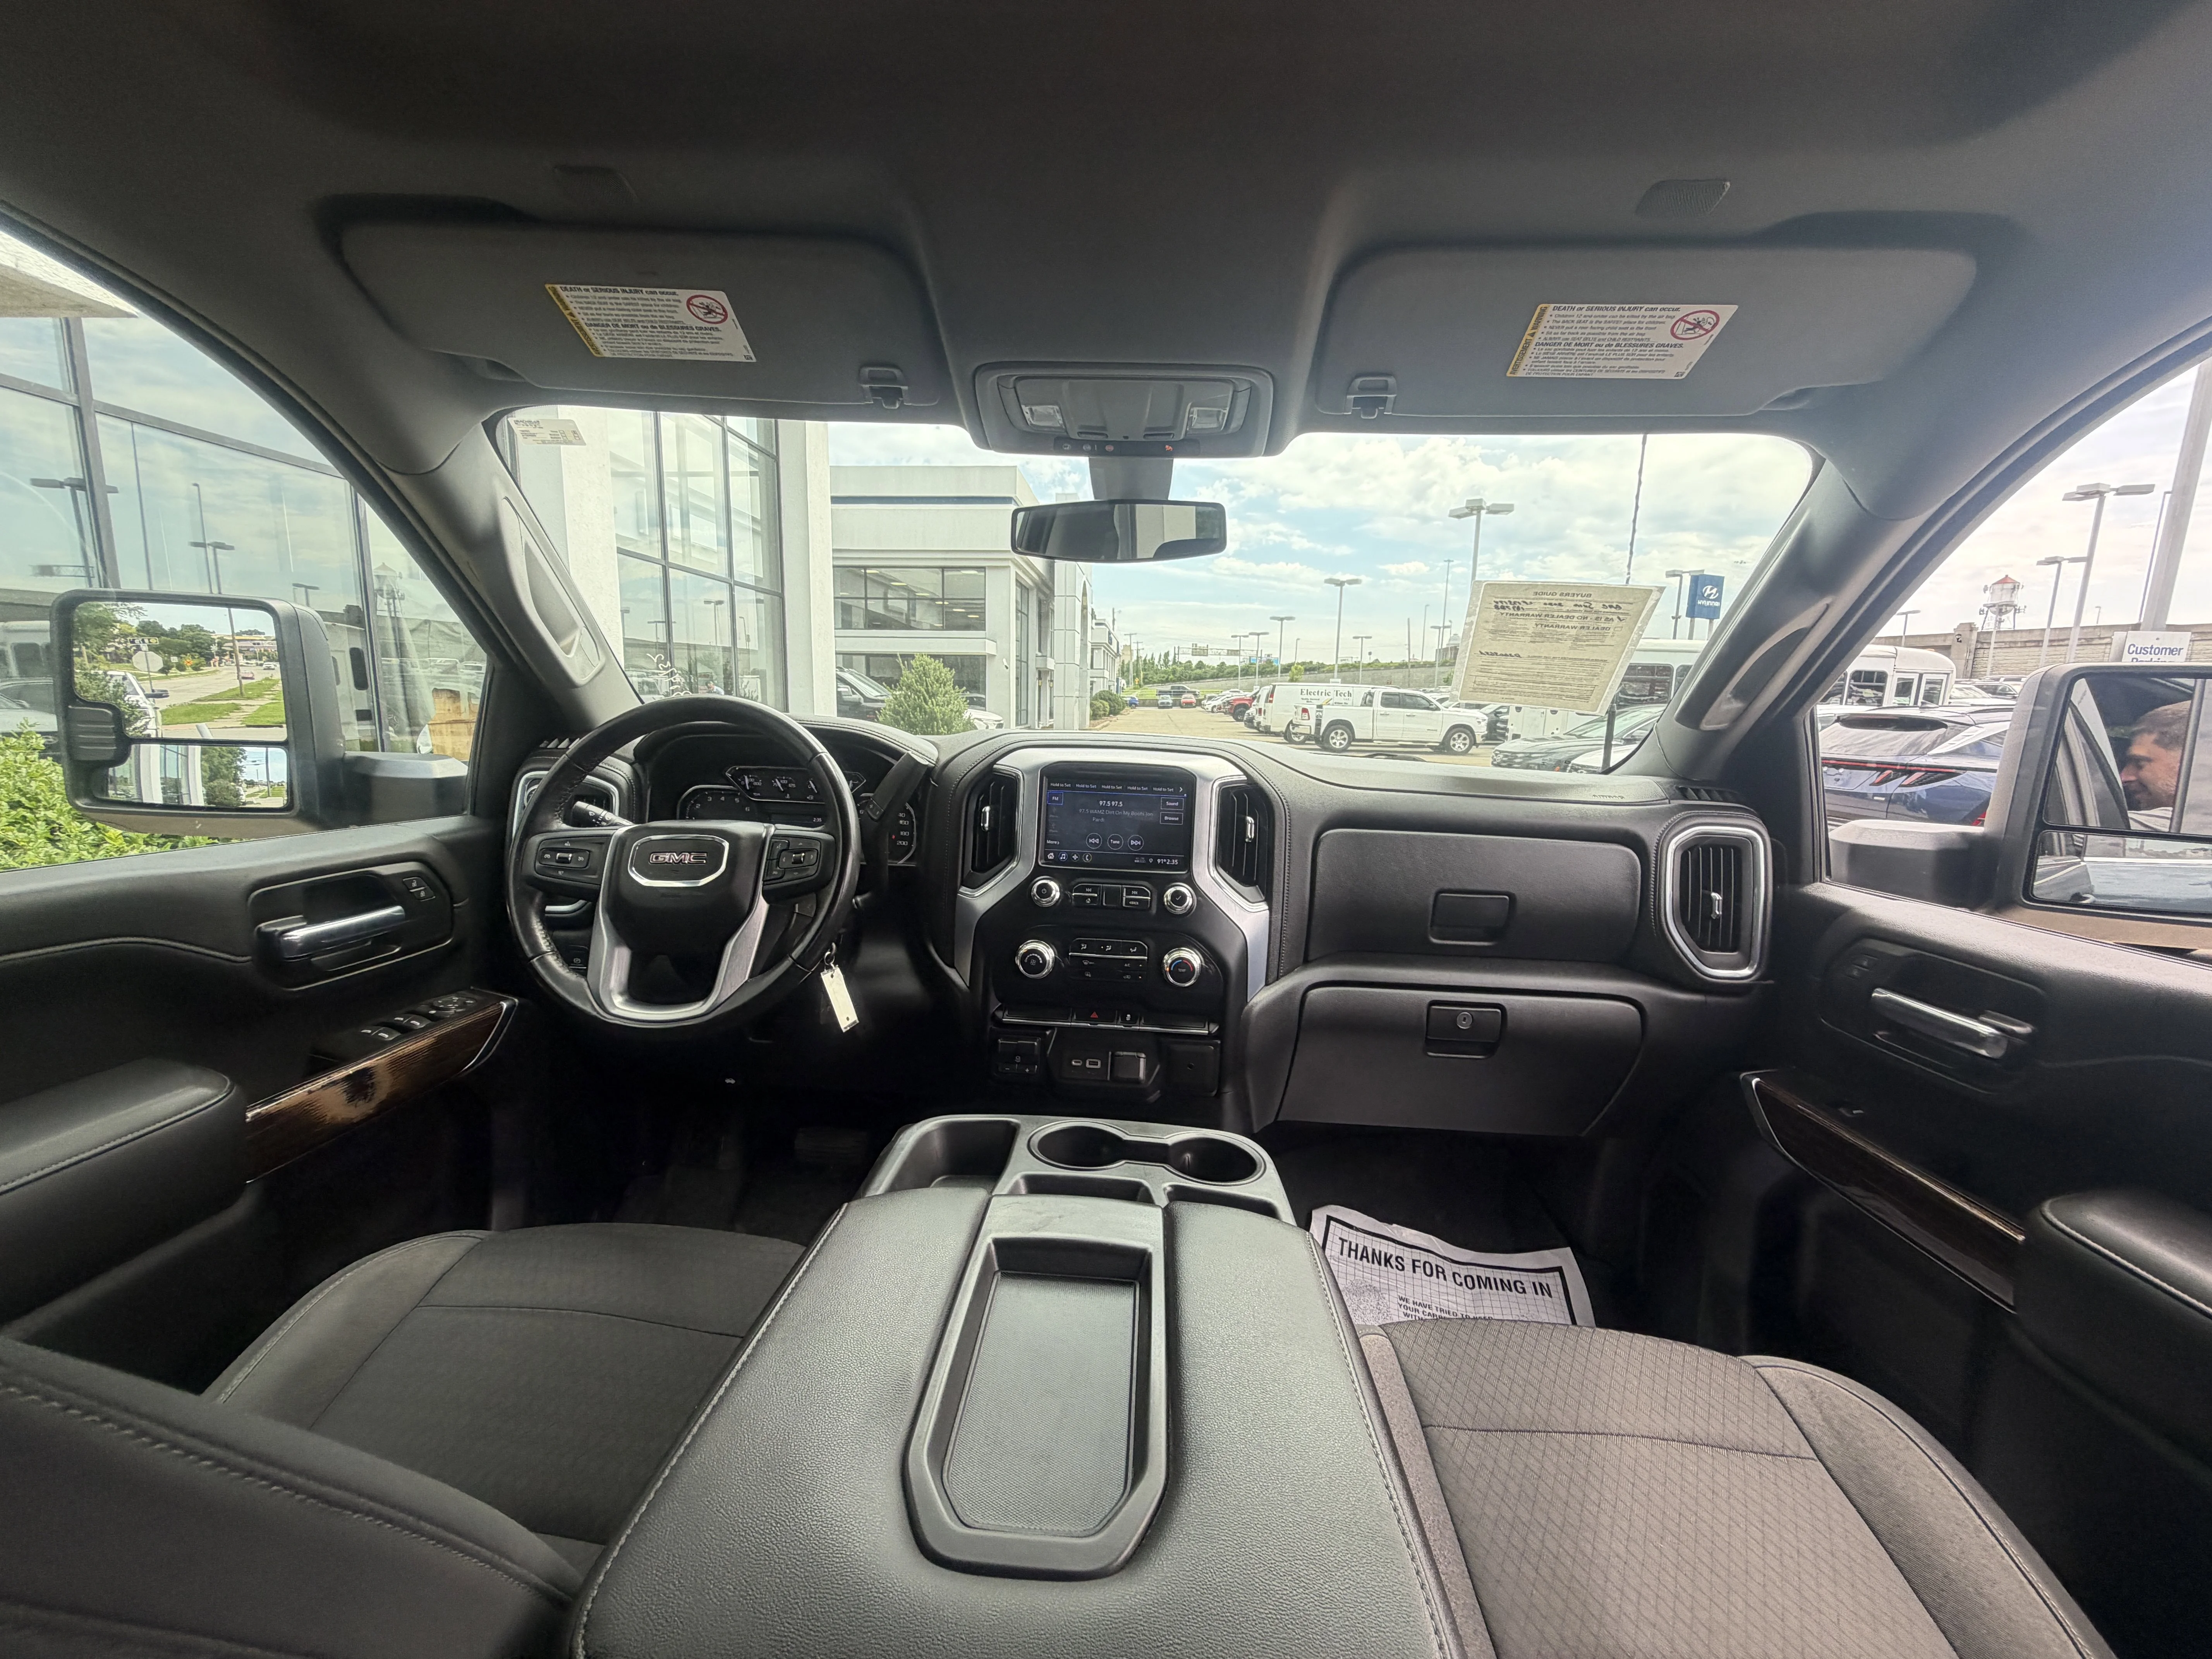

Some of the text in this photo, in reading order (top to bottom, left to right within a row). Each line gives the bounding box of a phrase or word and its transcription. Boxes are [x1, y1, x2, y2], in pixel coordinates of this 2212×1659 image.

[2128, 644, 2183, 656] Customer
[650, 853, 707, 864] GMC
[1339, 1237, 1553, 1298] THANKS FOR COMING IN
[1398, 1295, 1410, 1304] WE
[1412, 1300, 1432, 1310] HAVE
[1434, 1306, 1458, 1317] TRIED
[1398, 1302, 1419, 1314] YOUR
